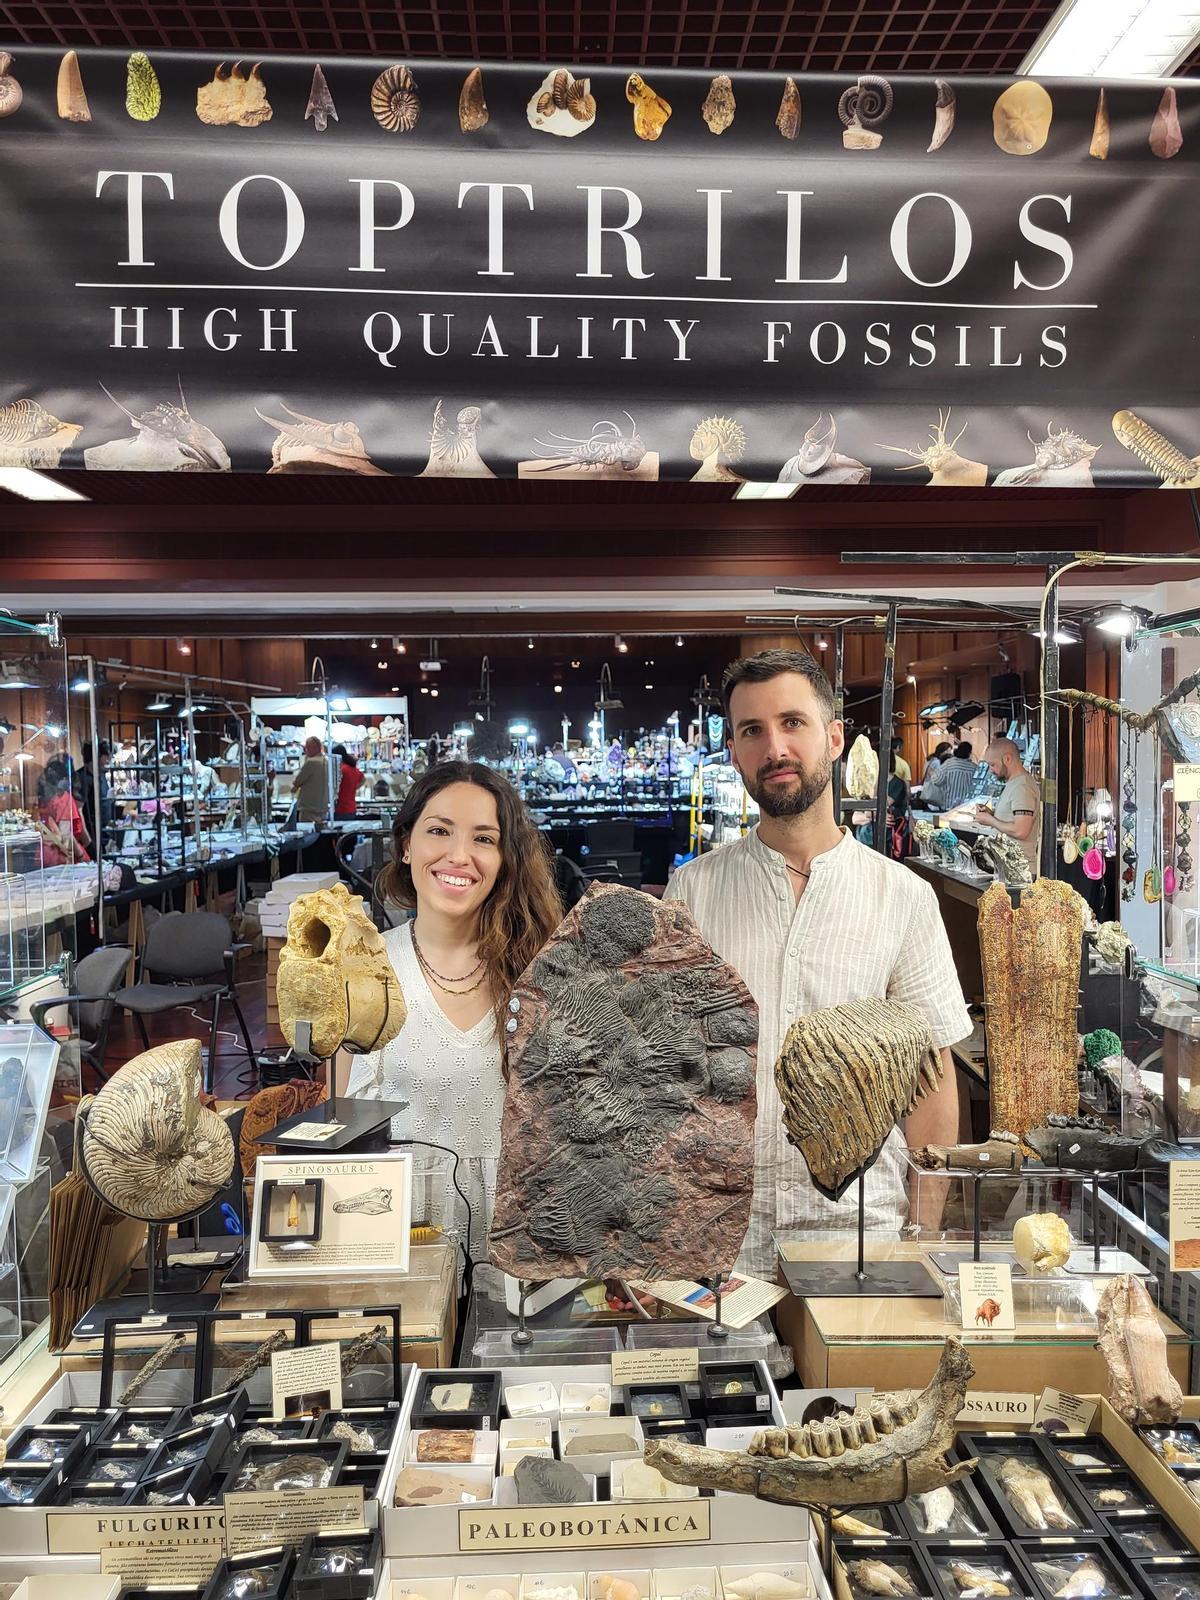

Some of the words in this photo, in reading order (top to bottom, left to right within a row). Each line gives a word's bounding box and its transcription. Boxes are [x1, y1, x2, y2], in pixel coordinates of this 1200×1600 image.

[95, 170, 1075, 291] TOPTRILOS
[109, 306, 298, 353] HIGH
[363, 311, 700, 368] QUALITY
[763, 320, 1068, 368] FOSSILS
[287, 1164, 375, 1175] SPINOSAURUS
[964, 1400, 1027, 1413] SSAURO
[468, 1513, 698, 1539] PALEOBOTÁNICA
